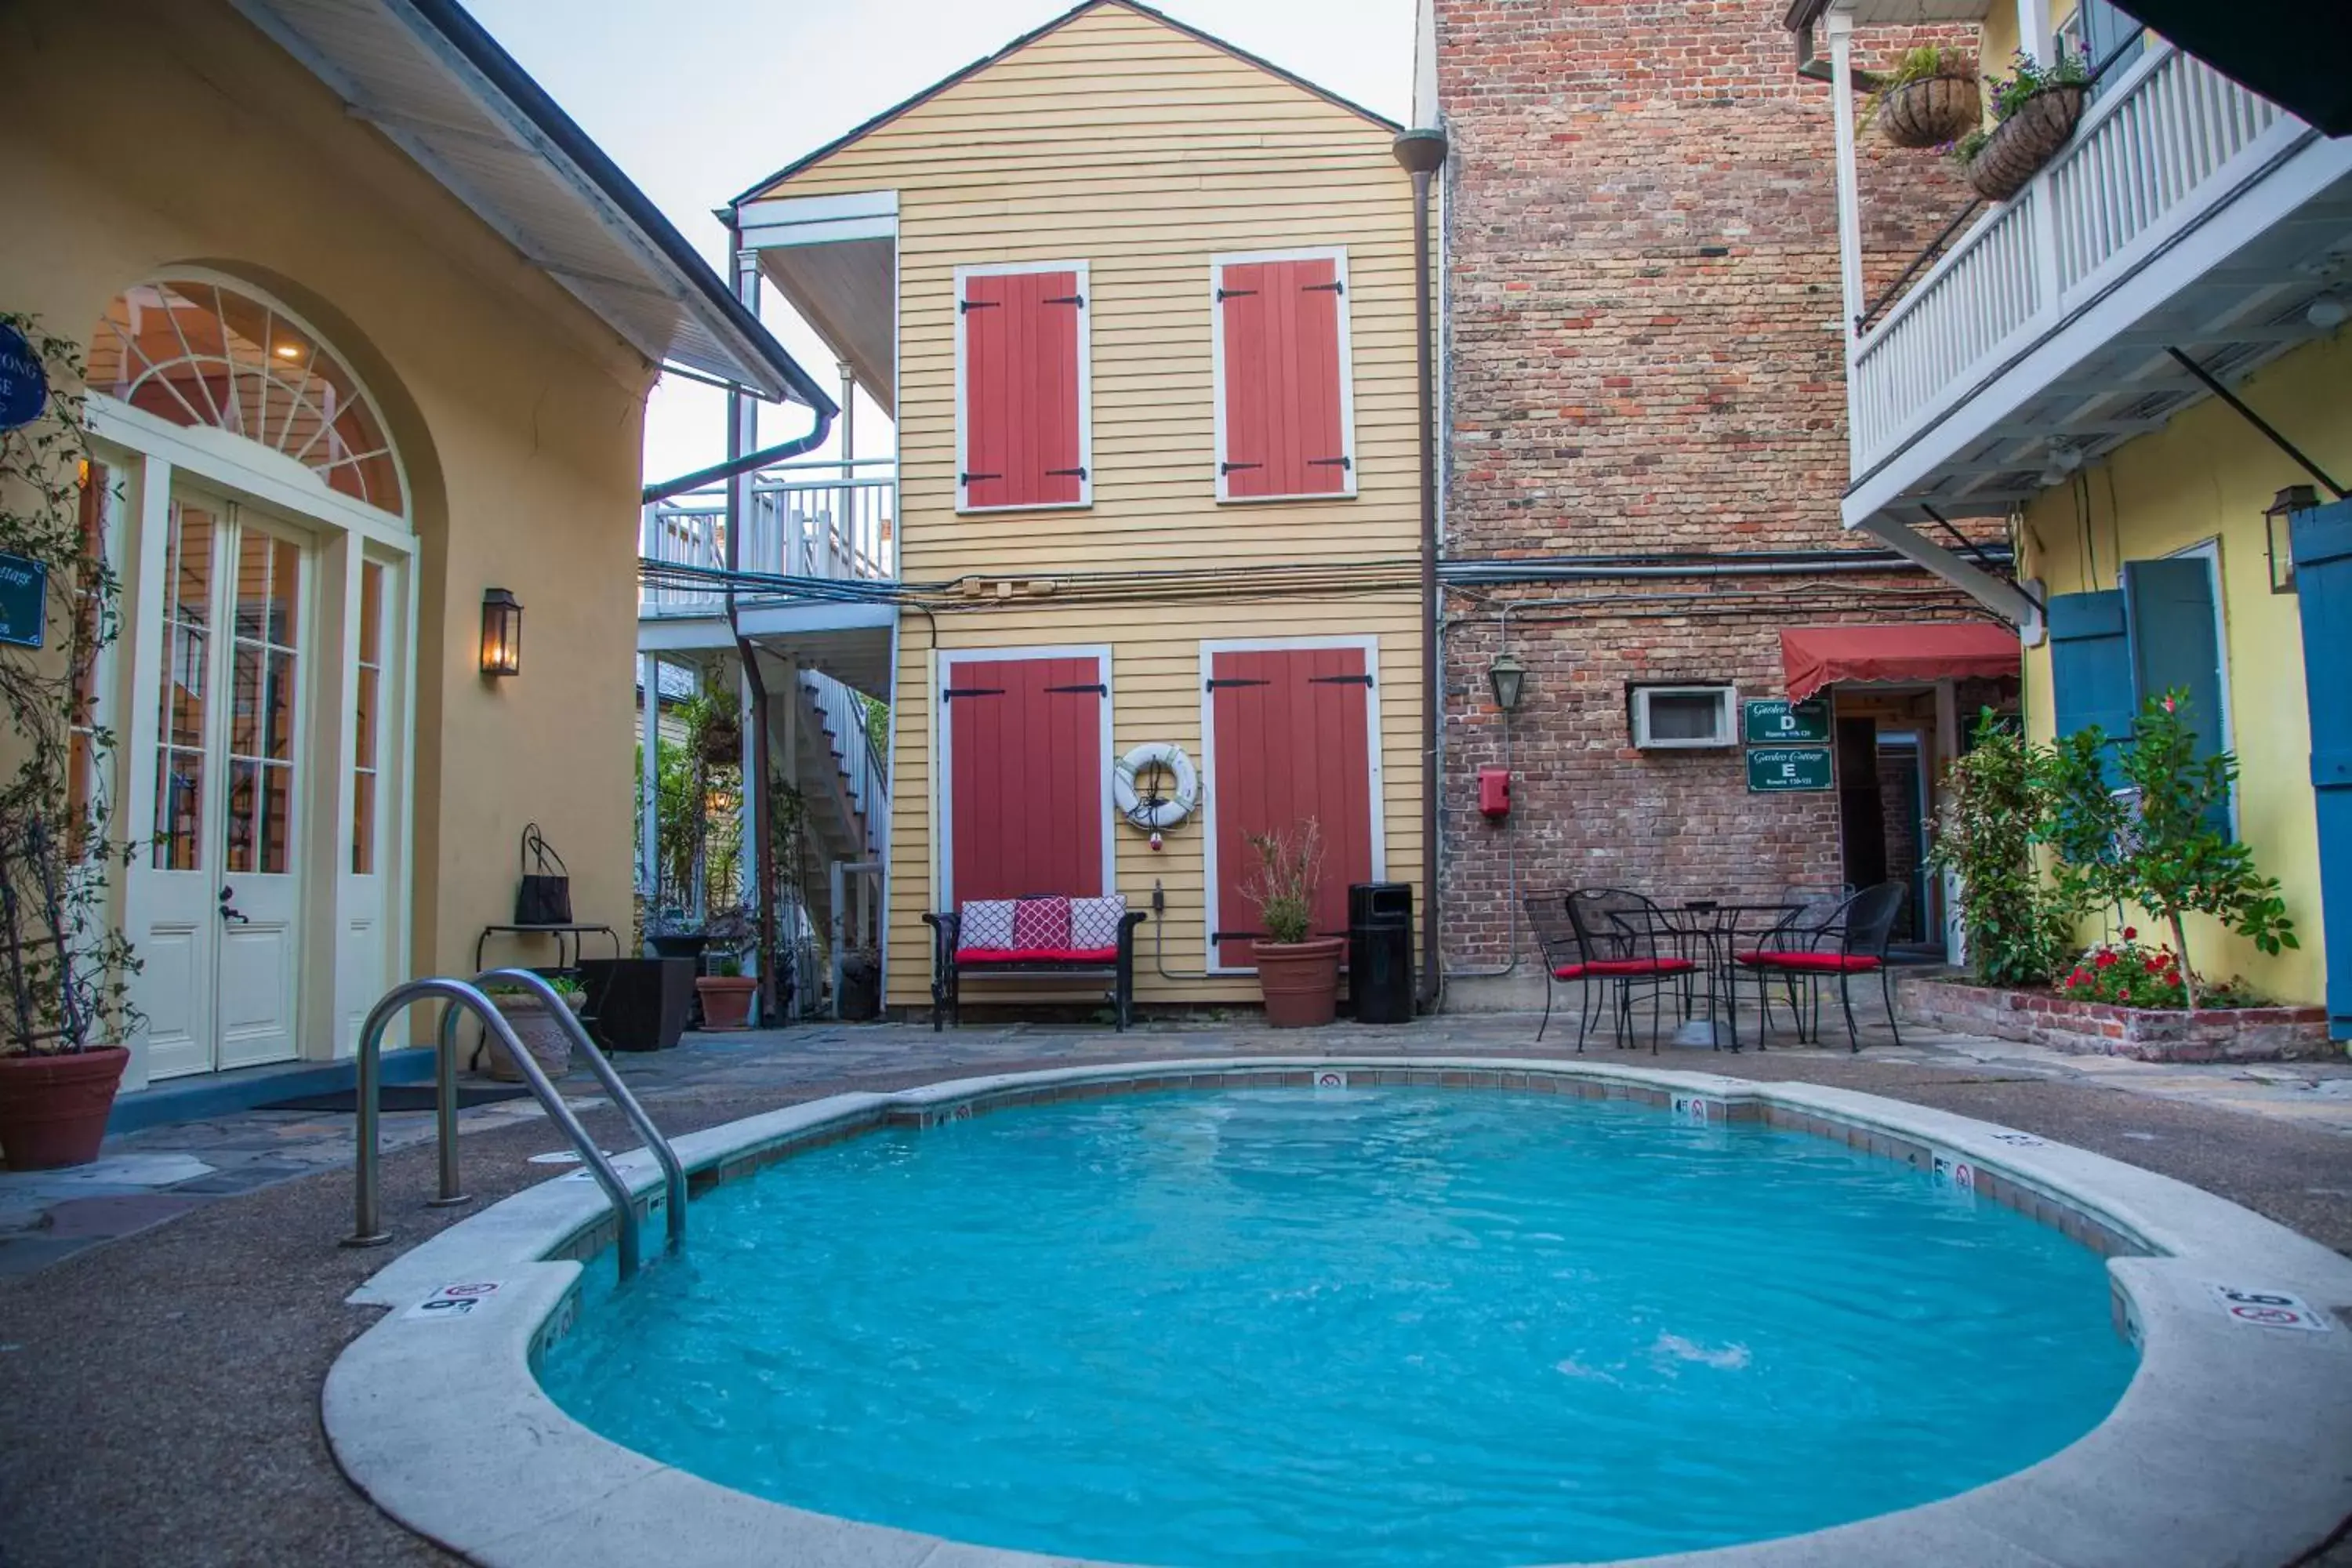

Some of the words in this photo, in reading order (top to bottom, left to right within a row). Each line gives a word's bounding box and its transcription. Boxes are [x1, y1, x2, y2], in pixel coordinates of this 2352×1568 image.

[0, 353, 38, 379] ONG
[1780, 716, 1795, 730] D
[1781, 763, 1796, 777] E
